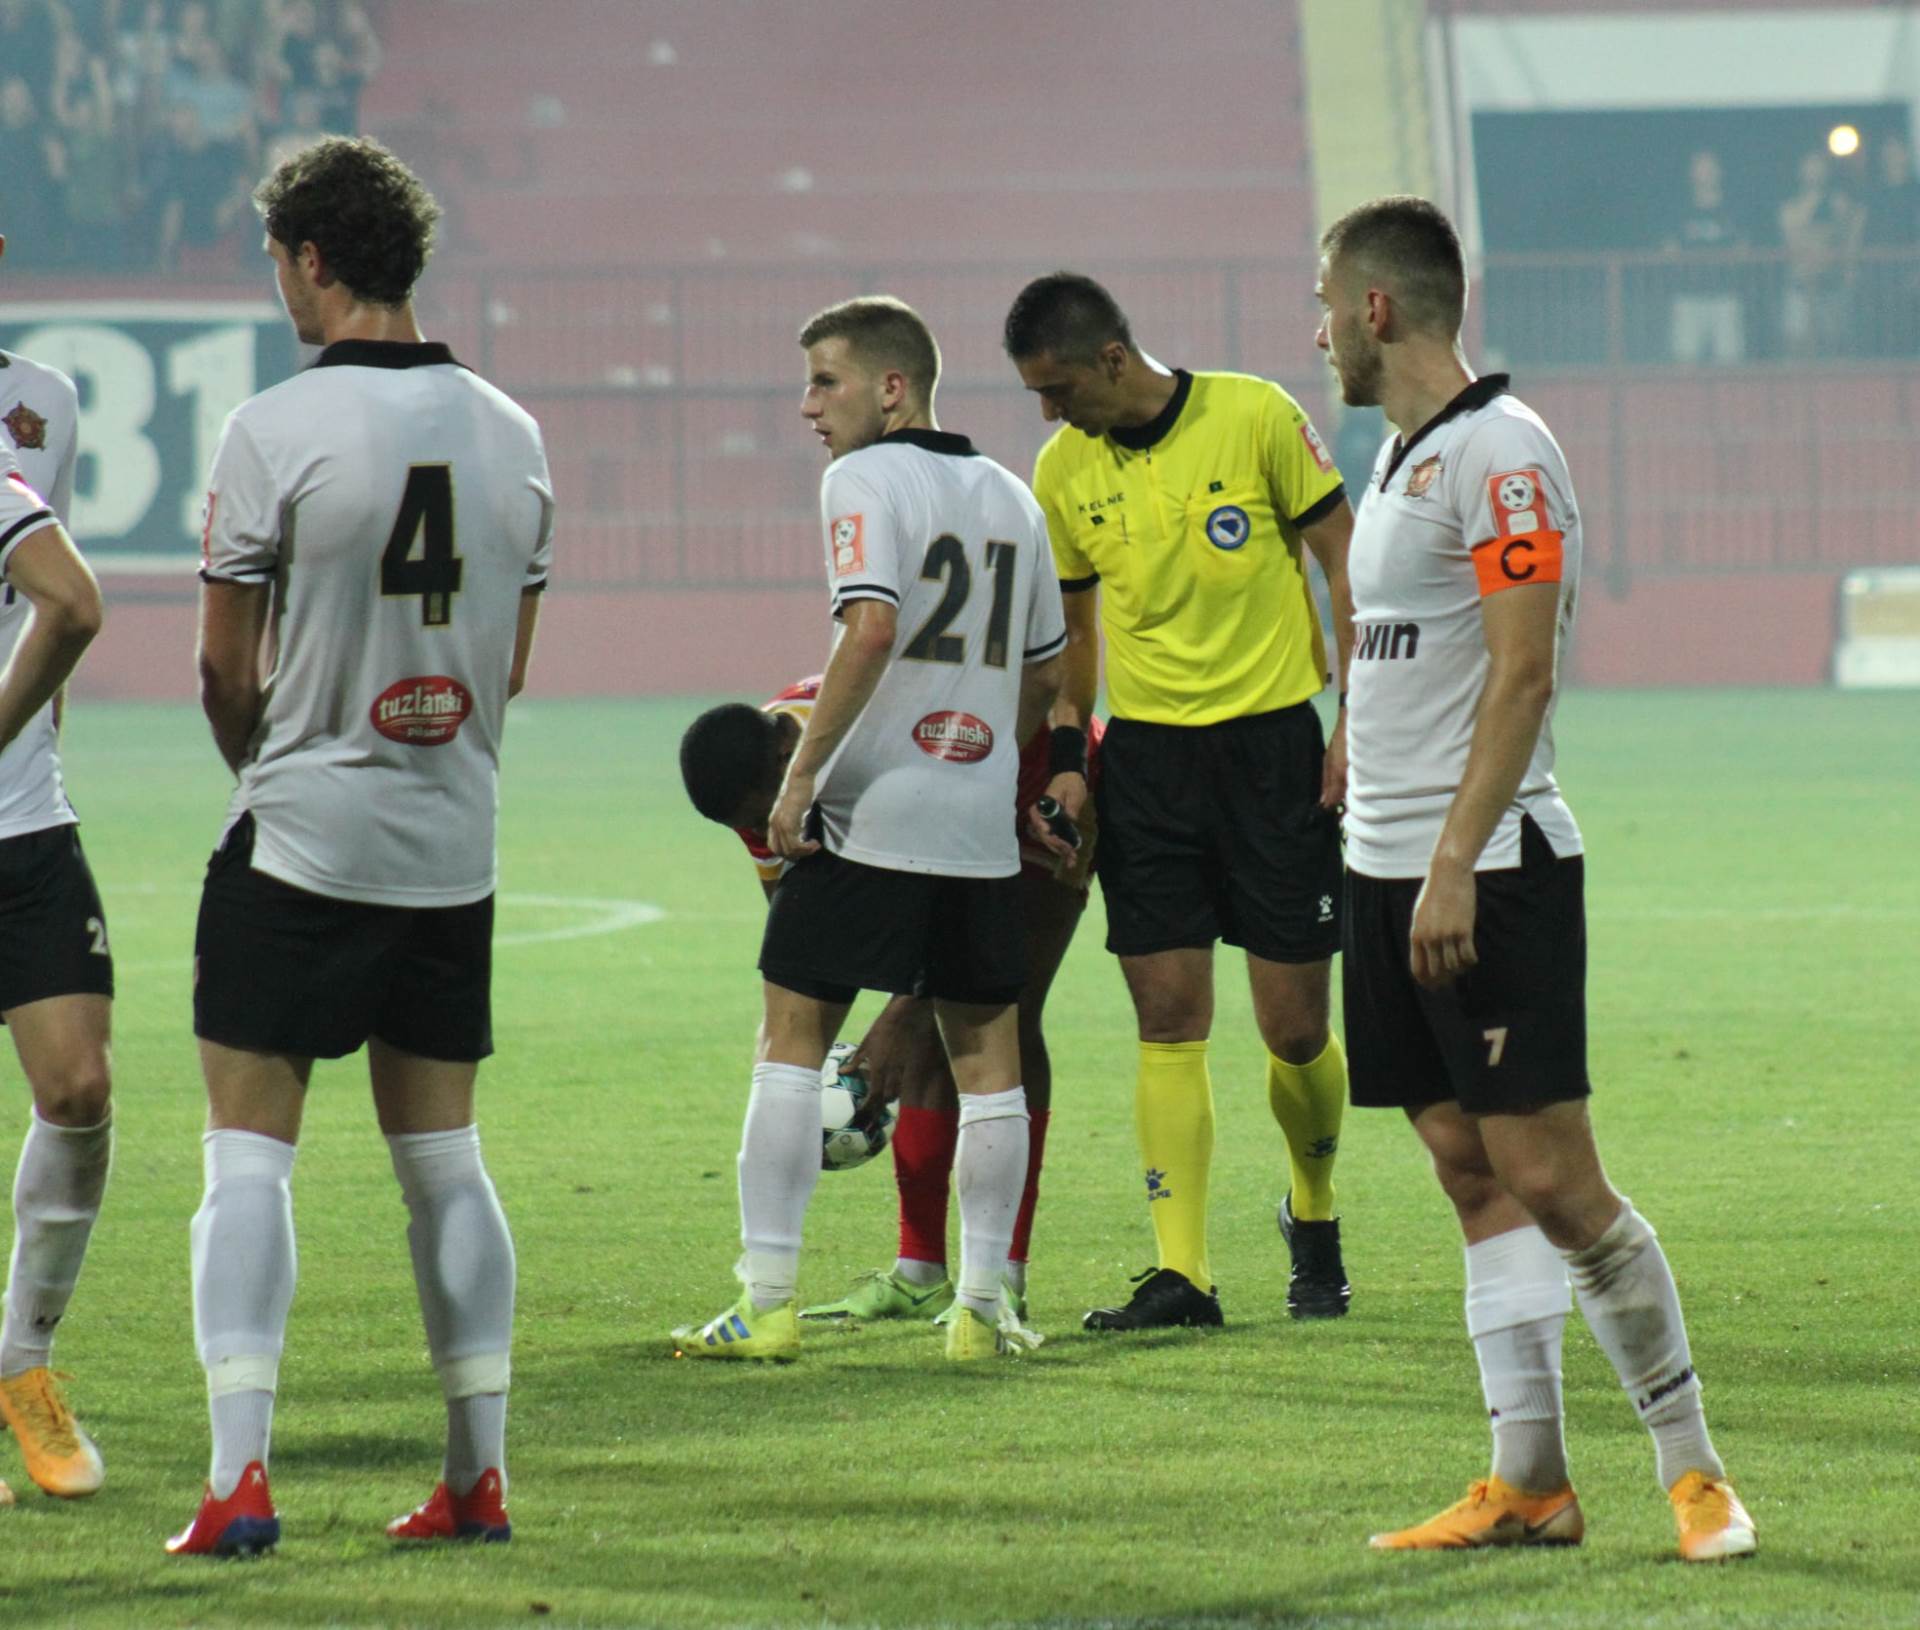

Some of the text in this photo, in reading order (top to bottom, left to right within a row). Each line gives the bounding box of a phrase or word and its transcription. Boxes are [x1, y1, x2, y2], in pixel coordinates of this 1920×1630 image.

[381, 465, 463, 628] 4
[1501, 539, 1537, 581] C
[899, 532, 1017, 671] 21
[86, 916, 107, 954] 2
[1483, 1027, 1508, 1066] 7
